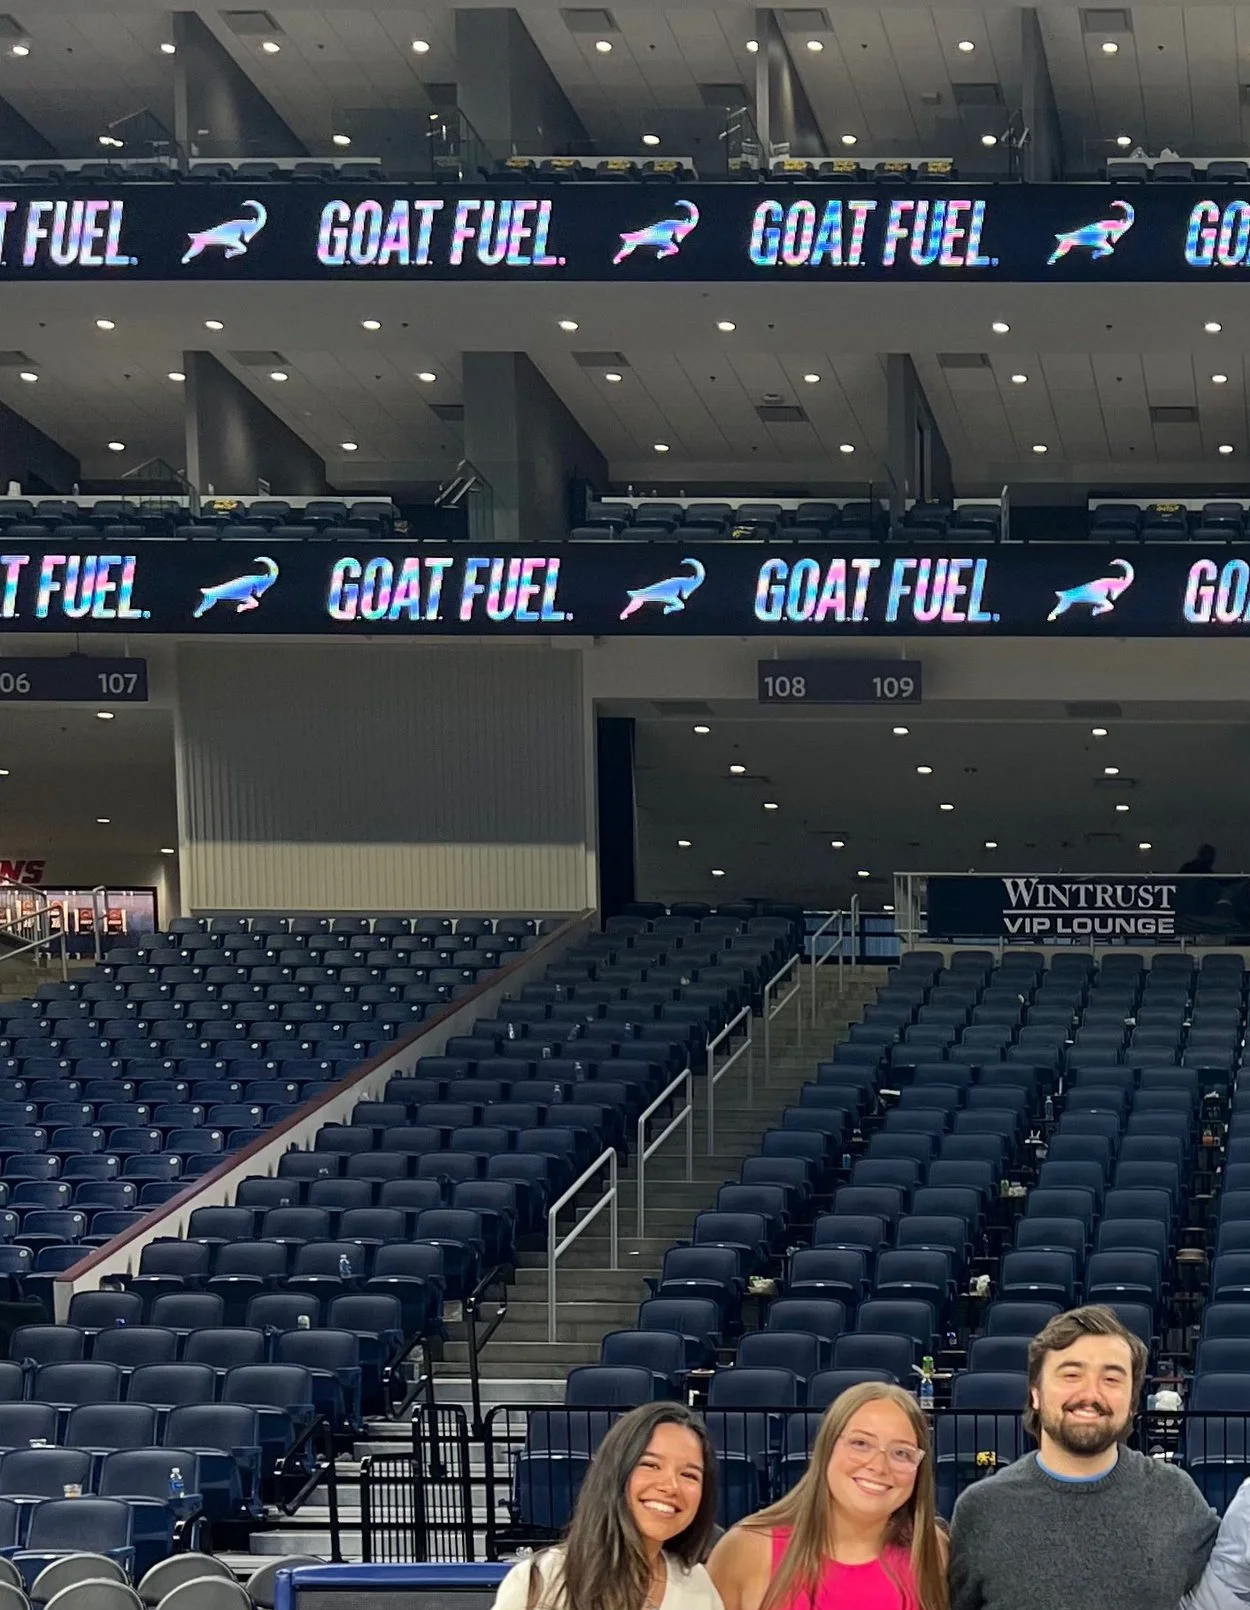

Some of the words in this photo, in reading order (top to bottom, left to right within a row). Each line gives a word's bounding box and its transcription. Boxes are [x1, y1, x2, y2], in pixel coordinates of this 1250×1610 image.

[98, 674, 138, 694] 107
[765, 676, 806, 697] 108
[872, 677, 914, 698] 109
[1003, 917, 1050, 934] VIP
[1057, 917, 1175, 934] LOUNGE
